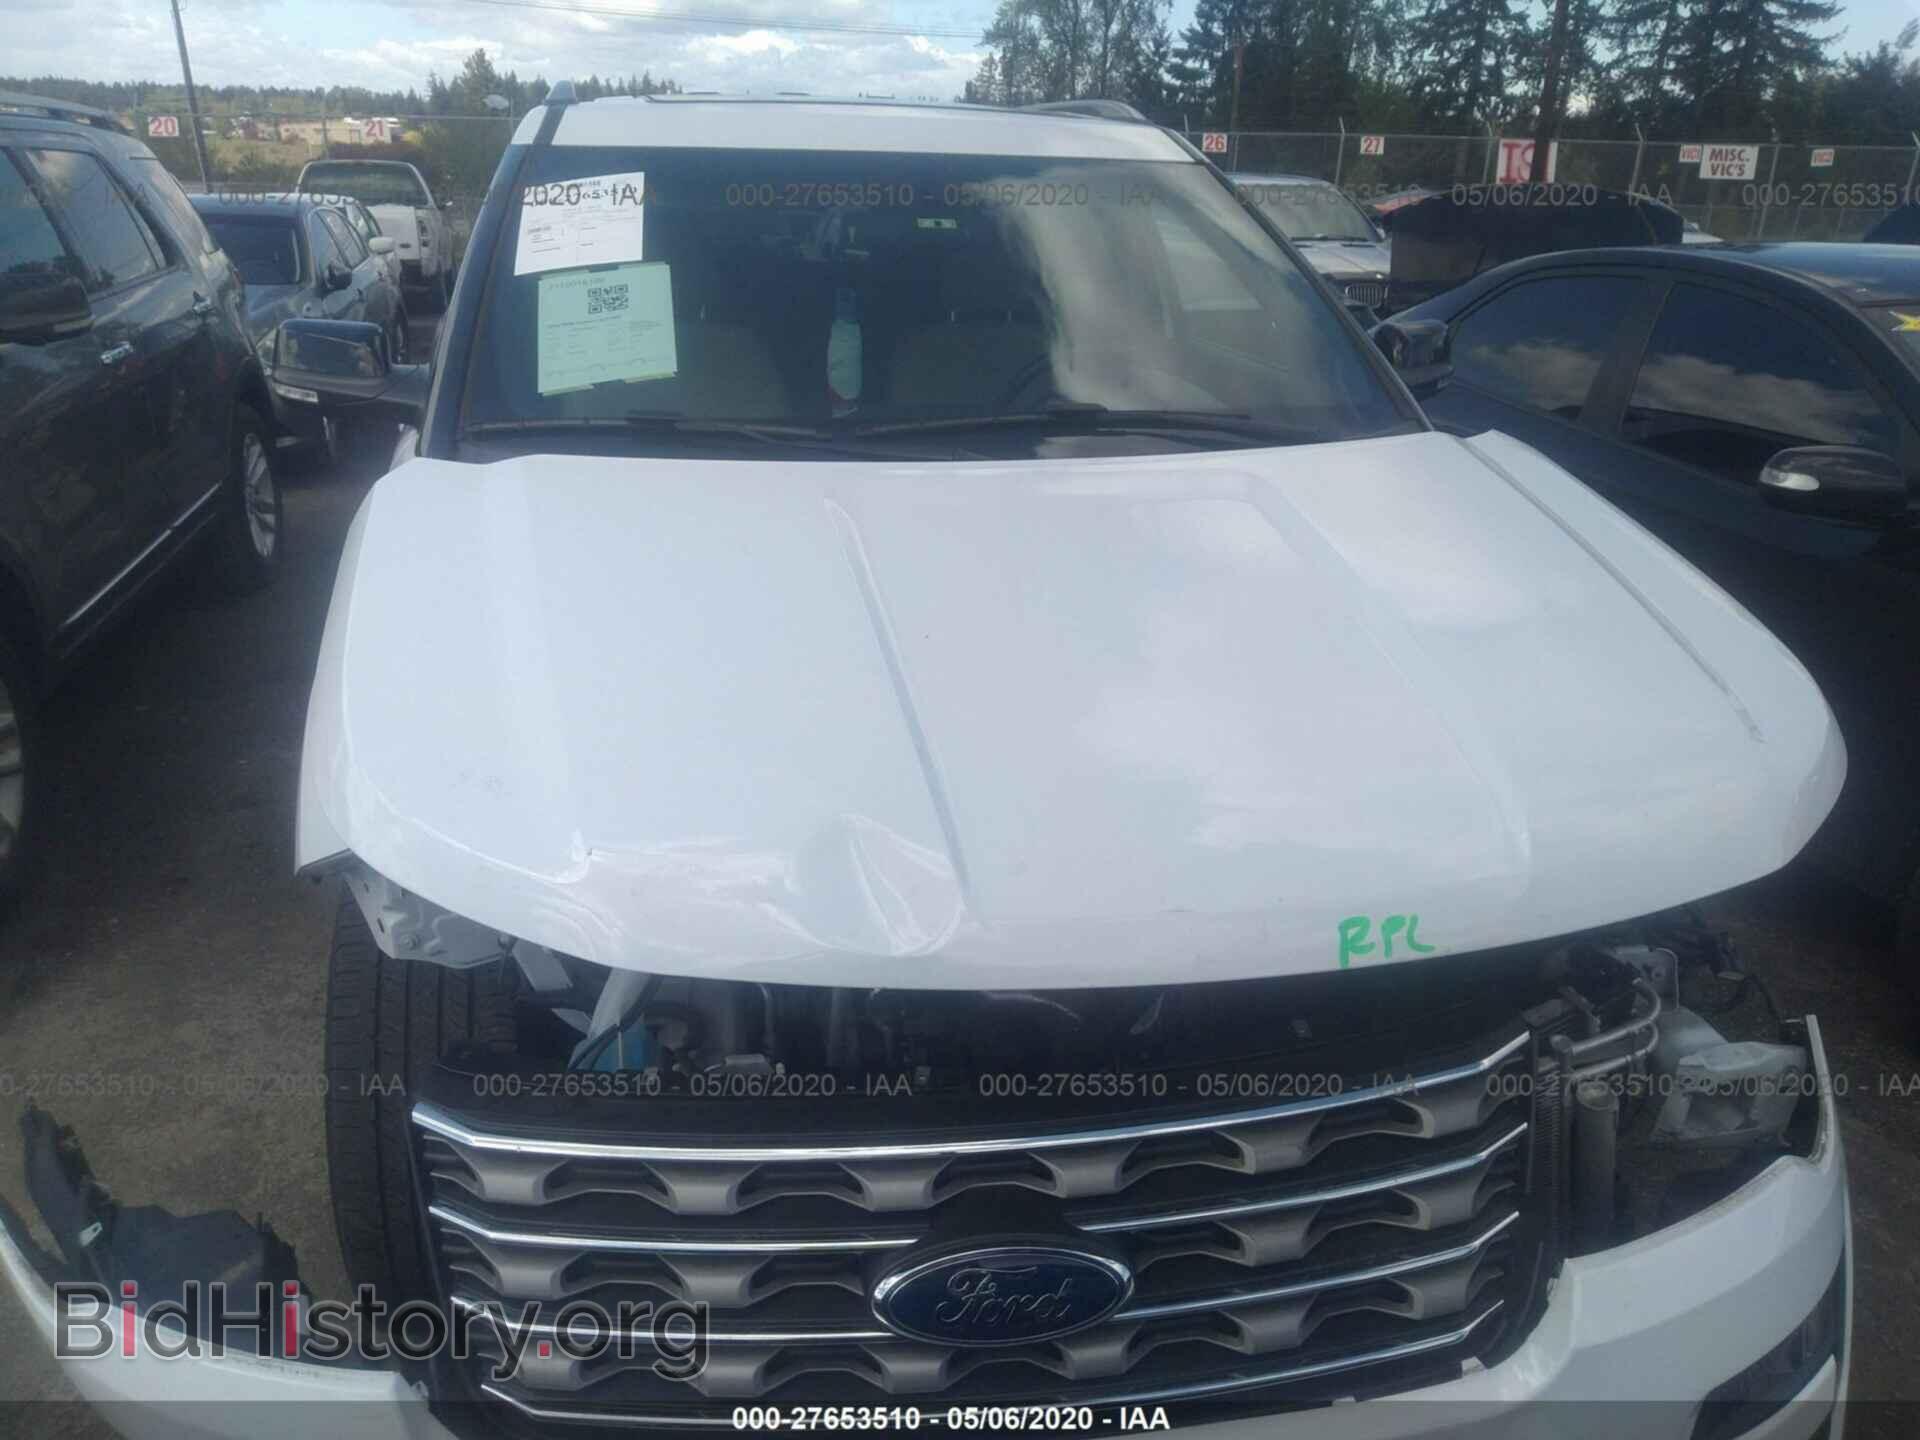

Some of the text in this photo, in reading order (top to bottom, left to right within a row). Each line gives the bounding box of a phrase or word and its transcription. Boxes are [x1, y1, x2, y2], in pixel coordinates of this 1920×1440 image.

[149, 117, 177, 137] 20
[365, 119, 386, 138] 21
[1204, 134, 1225, 151] 26
[1363, 137, 1381, 154] 27
[1709, 147, 1750, 162] MISC.
[1709, 163, 1745, 177] VIC'S
[1338, 914, 1436, 969] RPL
[935, 1265, 1074, 1327] Ford
